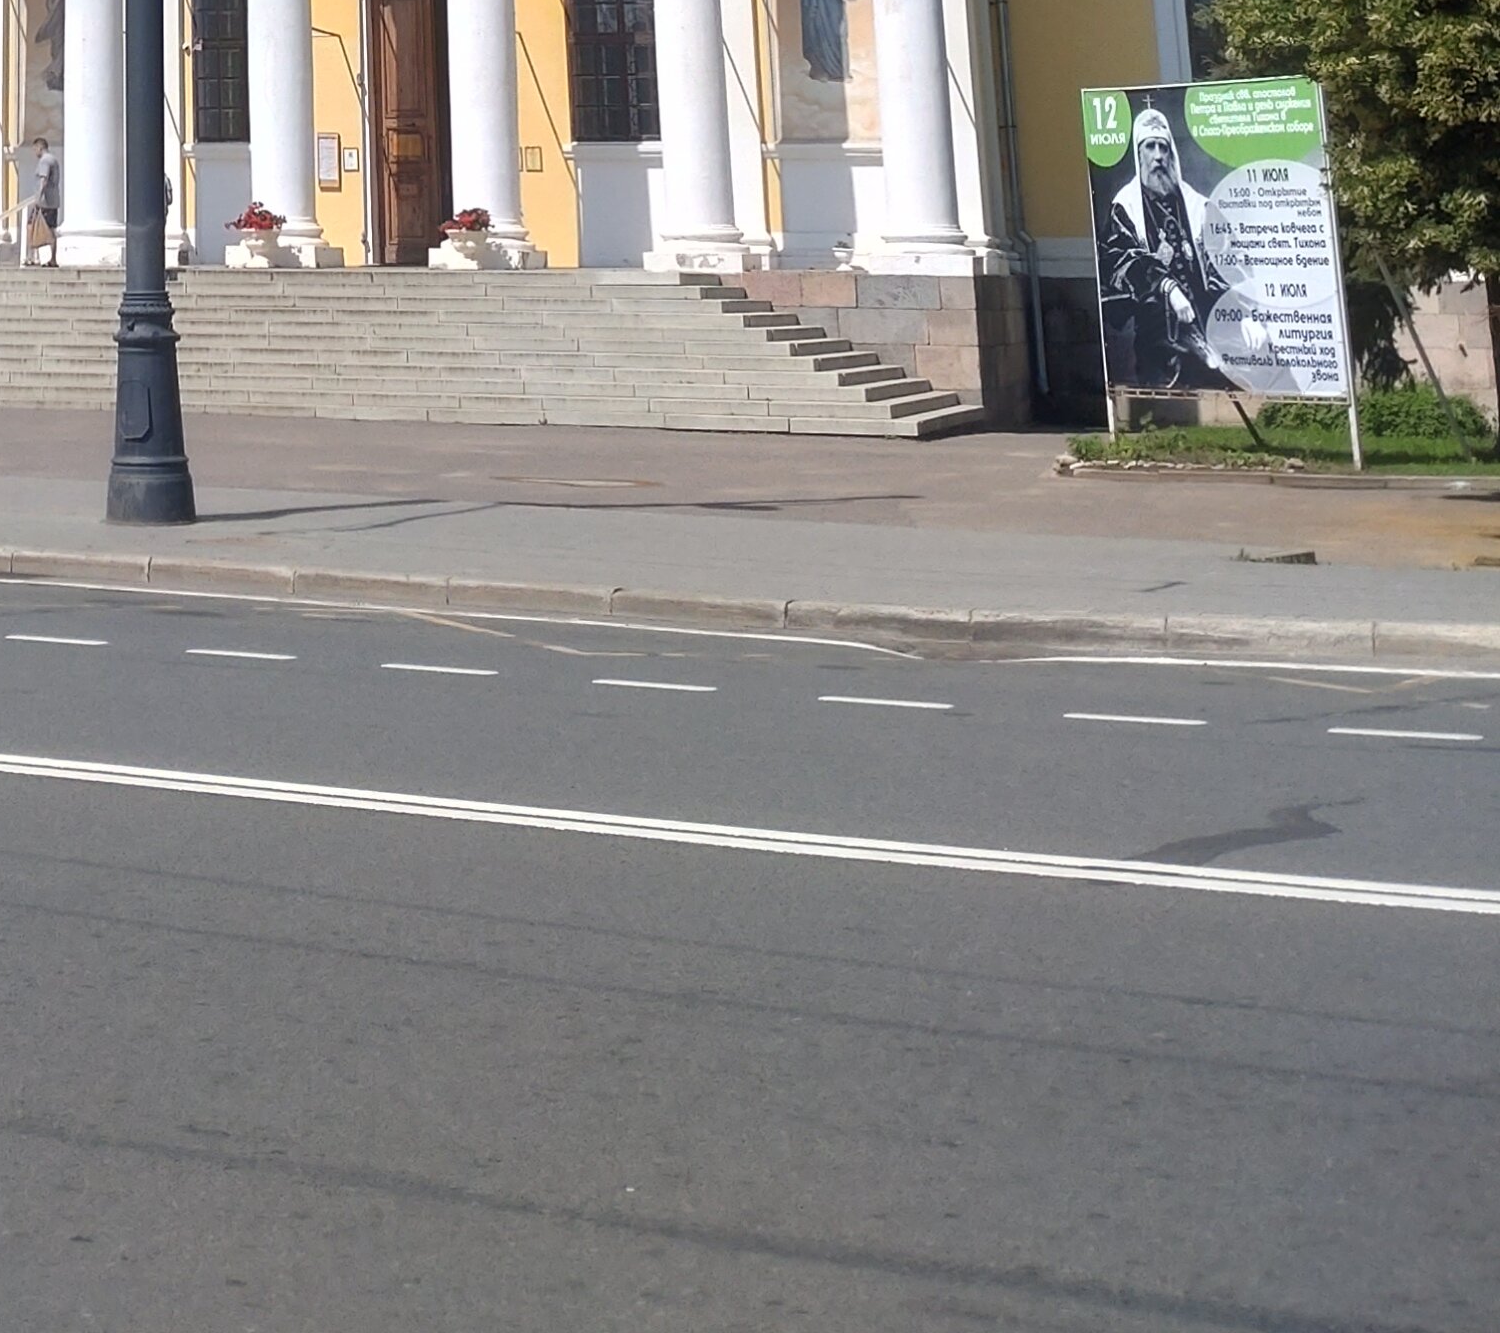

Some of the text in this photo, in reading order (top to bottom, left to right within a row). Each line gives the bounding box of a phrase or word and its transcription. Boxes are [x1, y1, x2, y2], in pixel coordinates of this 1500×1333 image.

[1093, 97, 1117, 130] 12
[1091, 132, 1126, 146] ИЮЛЯ
[1247, 168, 1289, 182] 11 ИЮЛЯ
[1229, 188, 1251, 198] 15:00
[1257, 187, 1307, 198] Открытие
[1258, 200, 1273, 210] под
[1297, 207, 1322, 217] небом
[1210, 223, 1232, 234] 16:45
[1239, 223, 1279, 236] Встреча
[1280, 222, 1317, 234] ковчега
[1319, 224, 1324, 233] с
[1230, 240, 1266, 250] мощами
[1293, 237, 1327, 249] Тихона
[1215, 255, 1237, 266] 17:00
[1244, 254, 1294, 268] Всенощное
[1295, 254, 1330, 268] бдение
[1265, 283, 1307, 297] 12 ИЮЛЯ
[1215, 309, 1242, 322] 09:00
[1251, 309, 1333, 324] Божественная
[1278, 329, 1333, 342] литургия
[1268, 343, 1336, 358] Крестный ход
[1222, 354, 1338, 369] Фестиваль колокольного
[1311, 369, 1339, 383] звона
